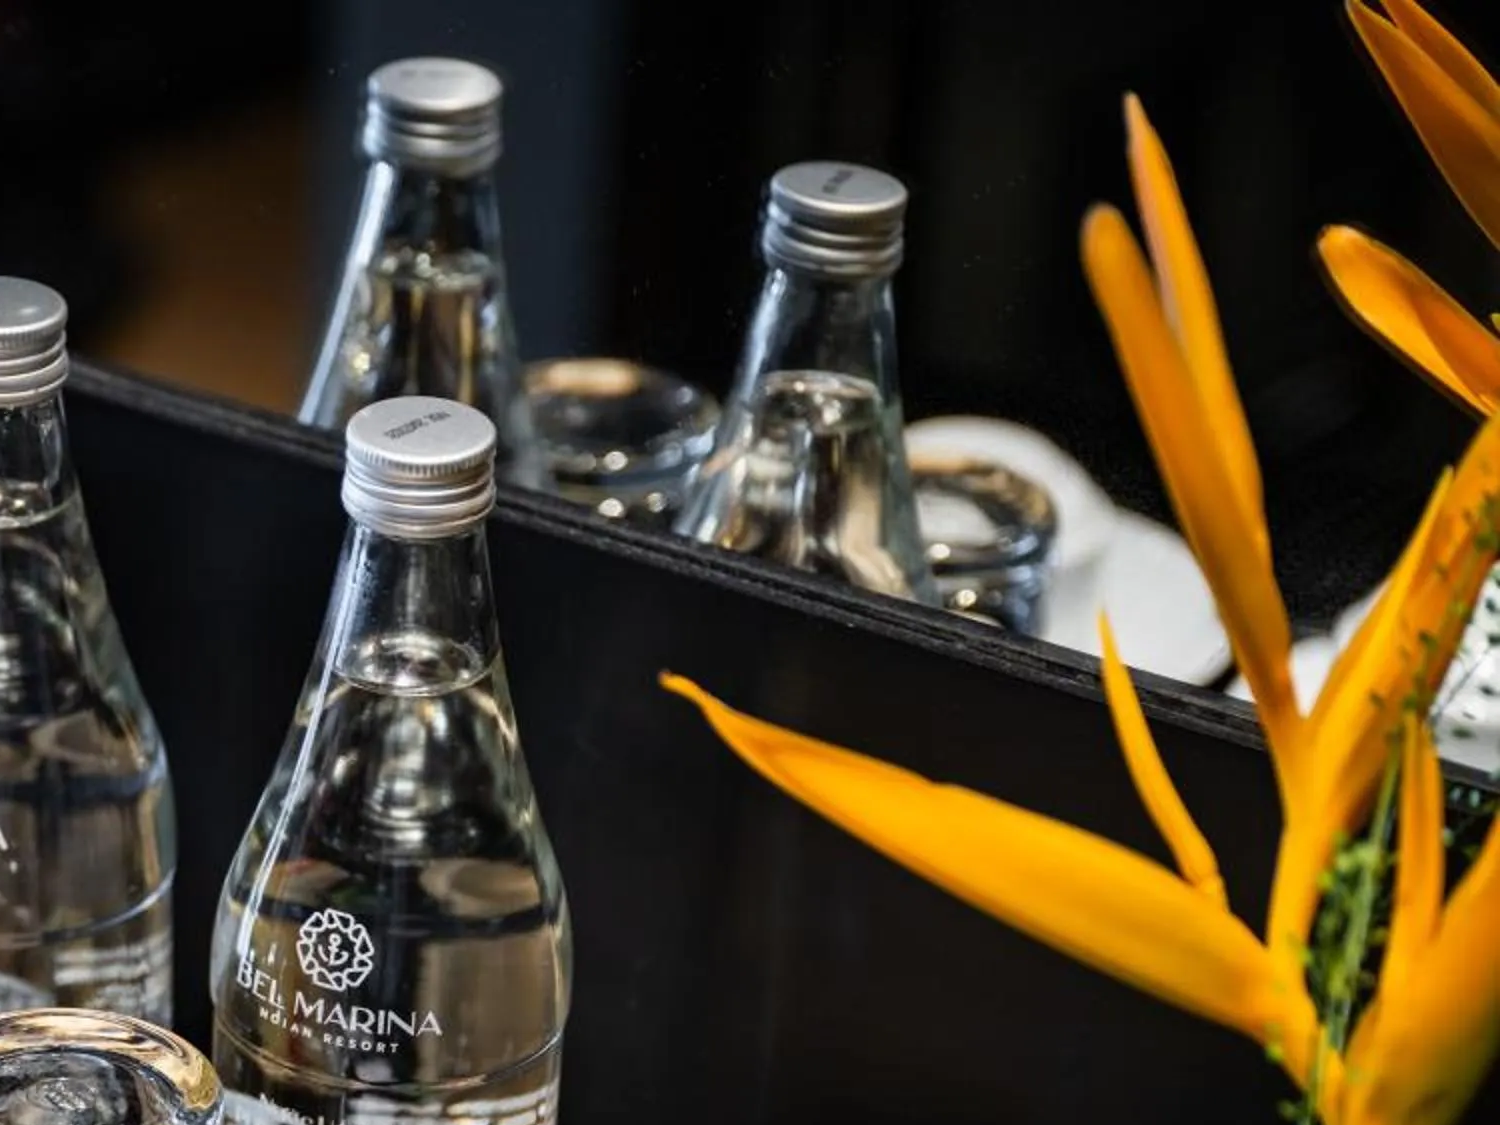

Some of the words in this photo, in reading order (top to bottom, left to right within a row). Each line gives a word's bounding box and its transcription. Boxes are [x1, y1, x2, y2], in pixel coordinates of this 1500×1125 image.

[236, 960, 285, 1010] BEL
[293, 991, 443, 1037] MARINA
[323, 1033, 400, 1055] RESORT
